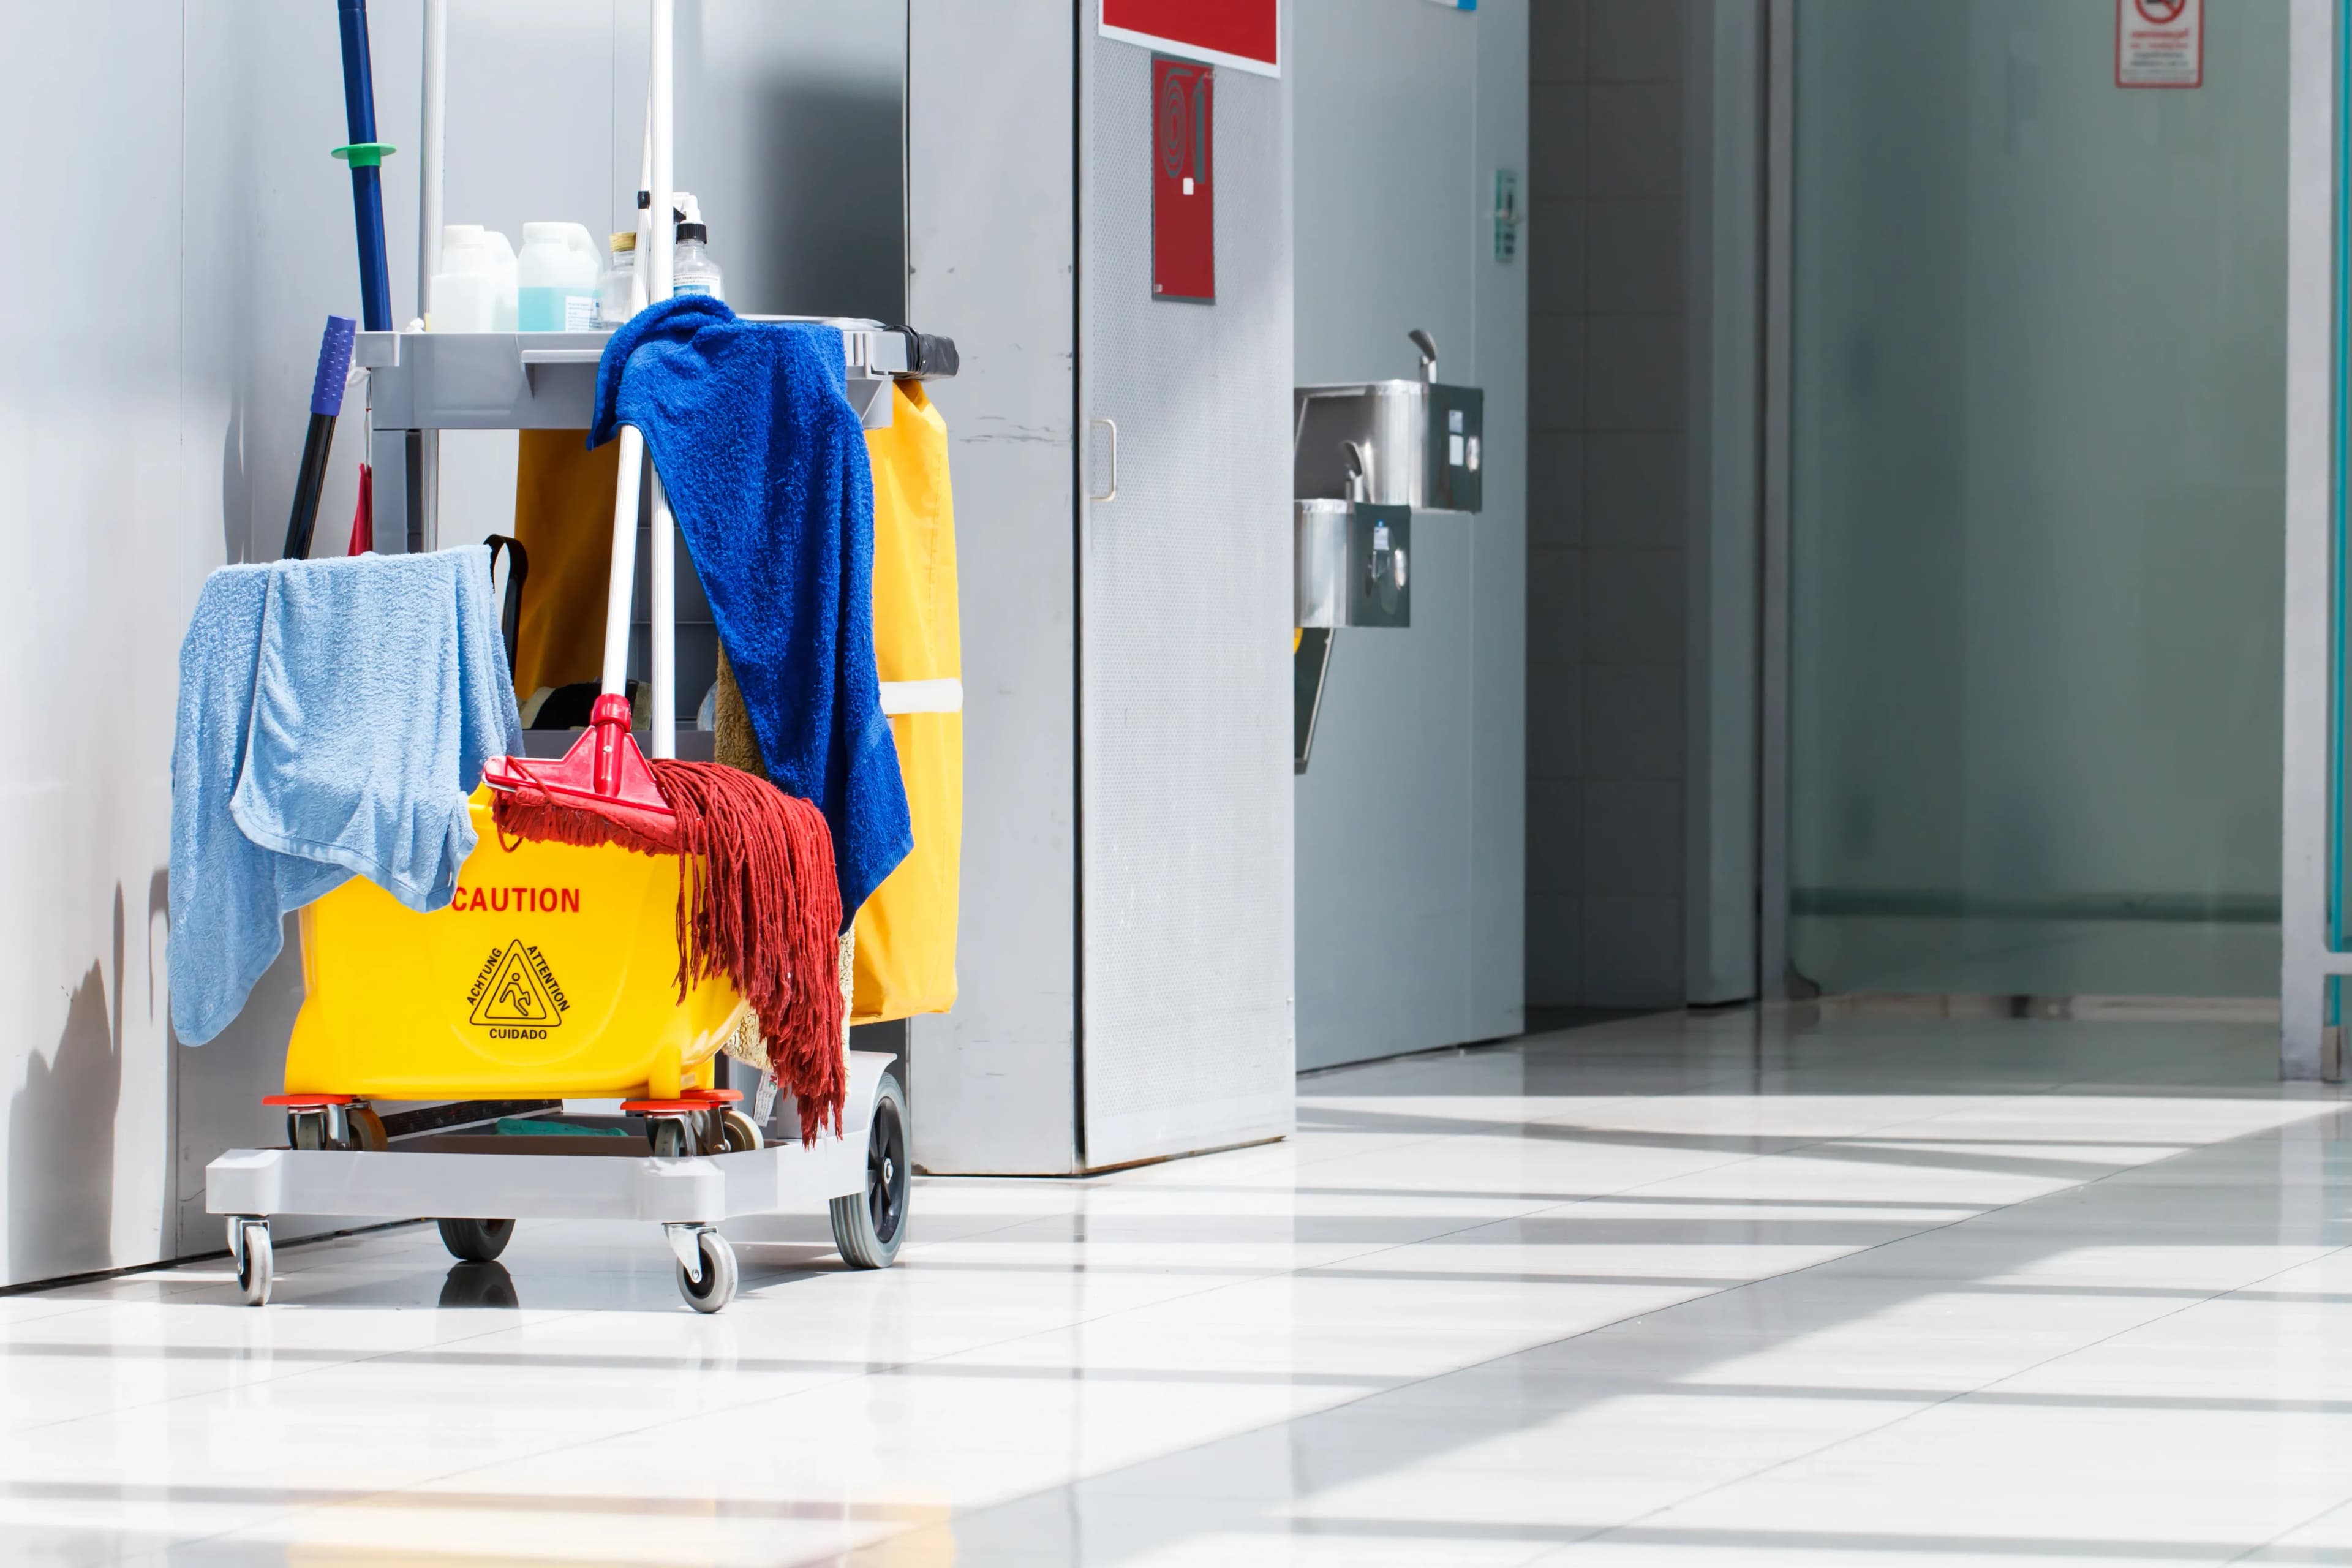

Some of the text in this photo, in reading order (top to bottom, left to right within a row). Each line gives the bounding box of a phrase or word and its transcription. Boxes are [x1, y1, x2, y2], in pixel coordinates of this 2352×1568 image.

[451, 886, 579, 913] CAUTION
[466, 948, 502, 1006] ACHTUNG
[527, 946, 570, 1012] ATTENTION
[489, 1028, 547, 1039] CUIDADO
